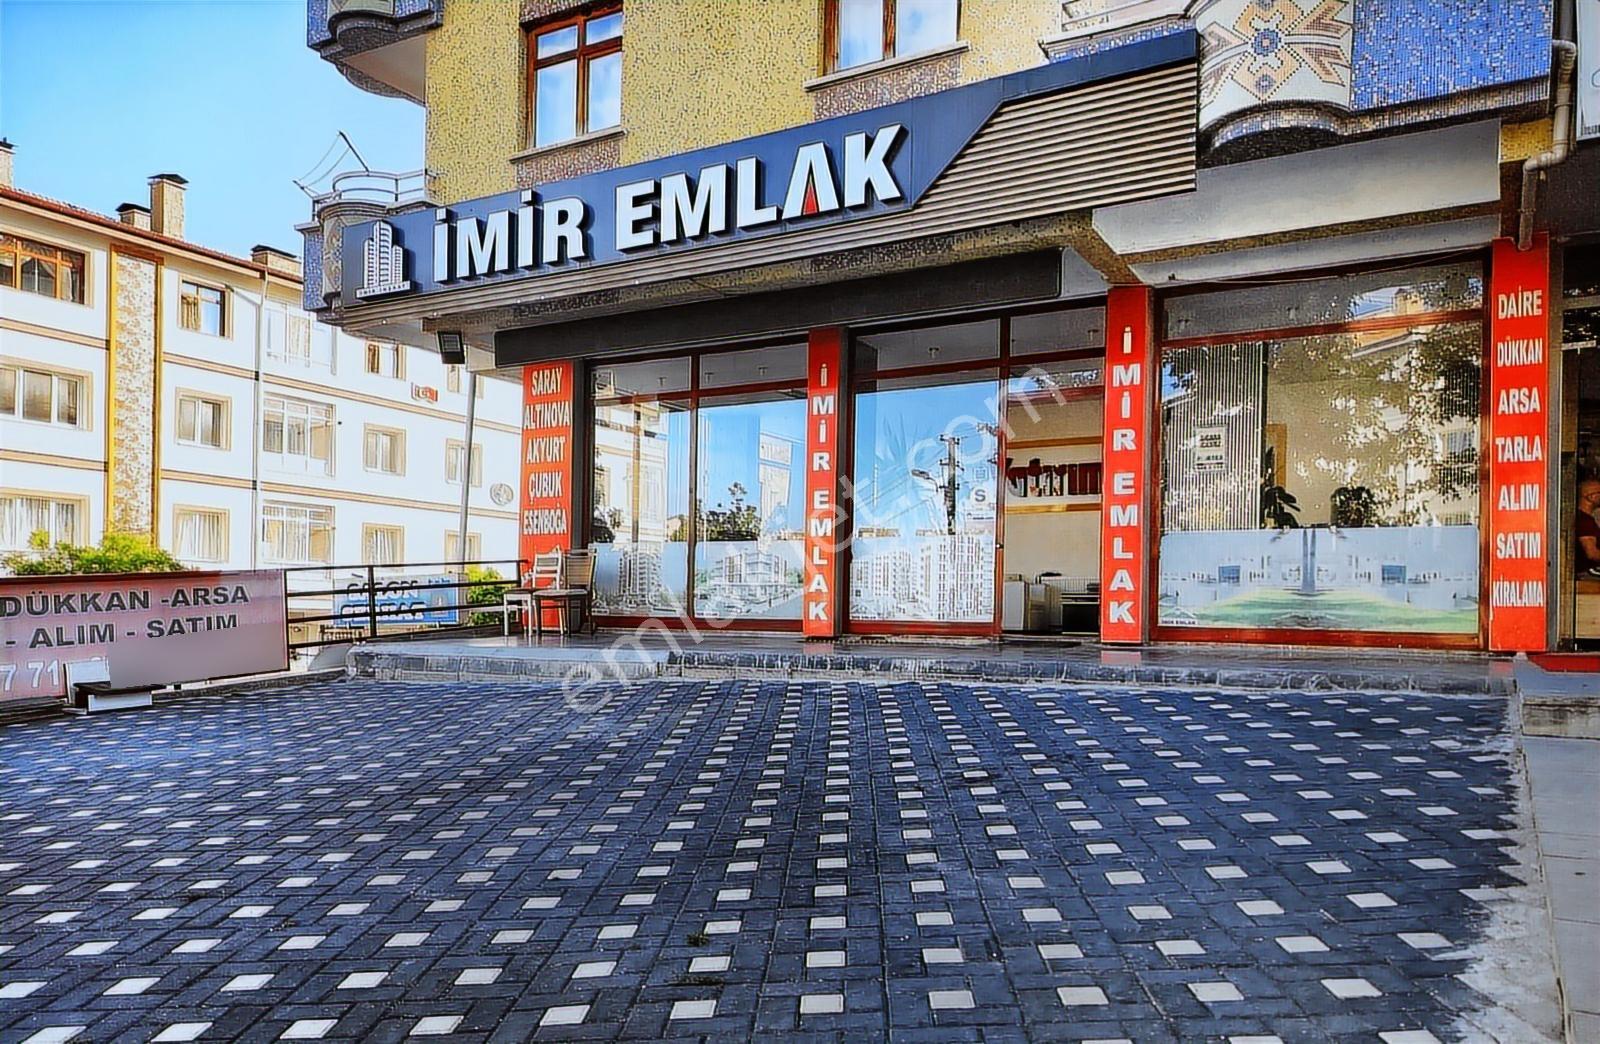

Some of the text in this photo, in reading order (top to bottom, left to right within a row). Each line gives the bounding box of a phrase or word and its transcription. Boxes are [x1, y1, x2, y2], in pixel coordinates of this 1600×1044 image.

[434, 124, 902, 282] İMİR EMLAK
[1498, 286, 1542, 319] DAİRE
[1497, 336, 1542, 367] DÜKKAN
[531, 367, 563, 396] SARAY
[523, 401, 571, 429] ALTINOVA
[1497, 388, 1540, 415] ARSA
[526, 436, 566, 464] AKYURT
[1495, 437, 1543, 463] TARLA
[529, 471, 562, 503] ÇUBUK
[1109, 326, 1141, 624] İMİR EMLAK
[808, 363, 835, 622] İMİR EMLAK
[1498, 484, 1540, 511] ALIM
[523, 501, 567, 535] ESENBOĞA
[1496, 532, 1541, 560] SATIM
[0, 590, 149, 617] DÜKKAN
[1492, 575, 1544, 608] KİRALAMA
[29, 624, 115, 649] ALIM
[147, 614, 237, 638] SATIM
[28, 660, 59, 688] 71
